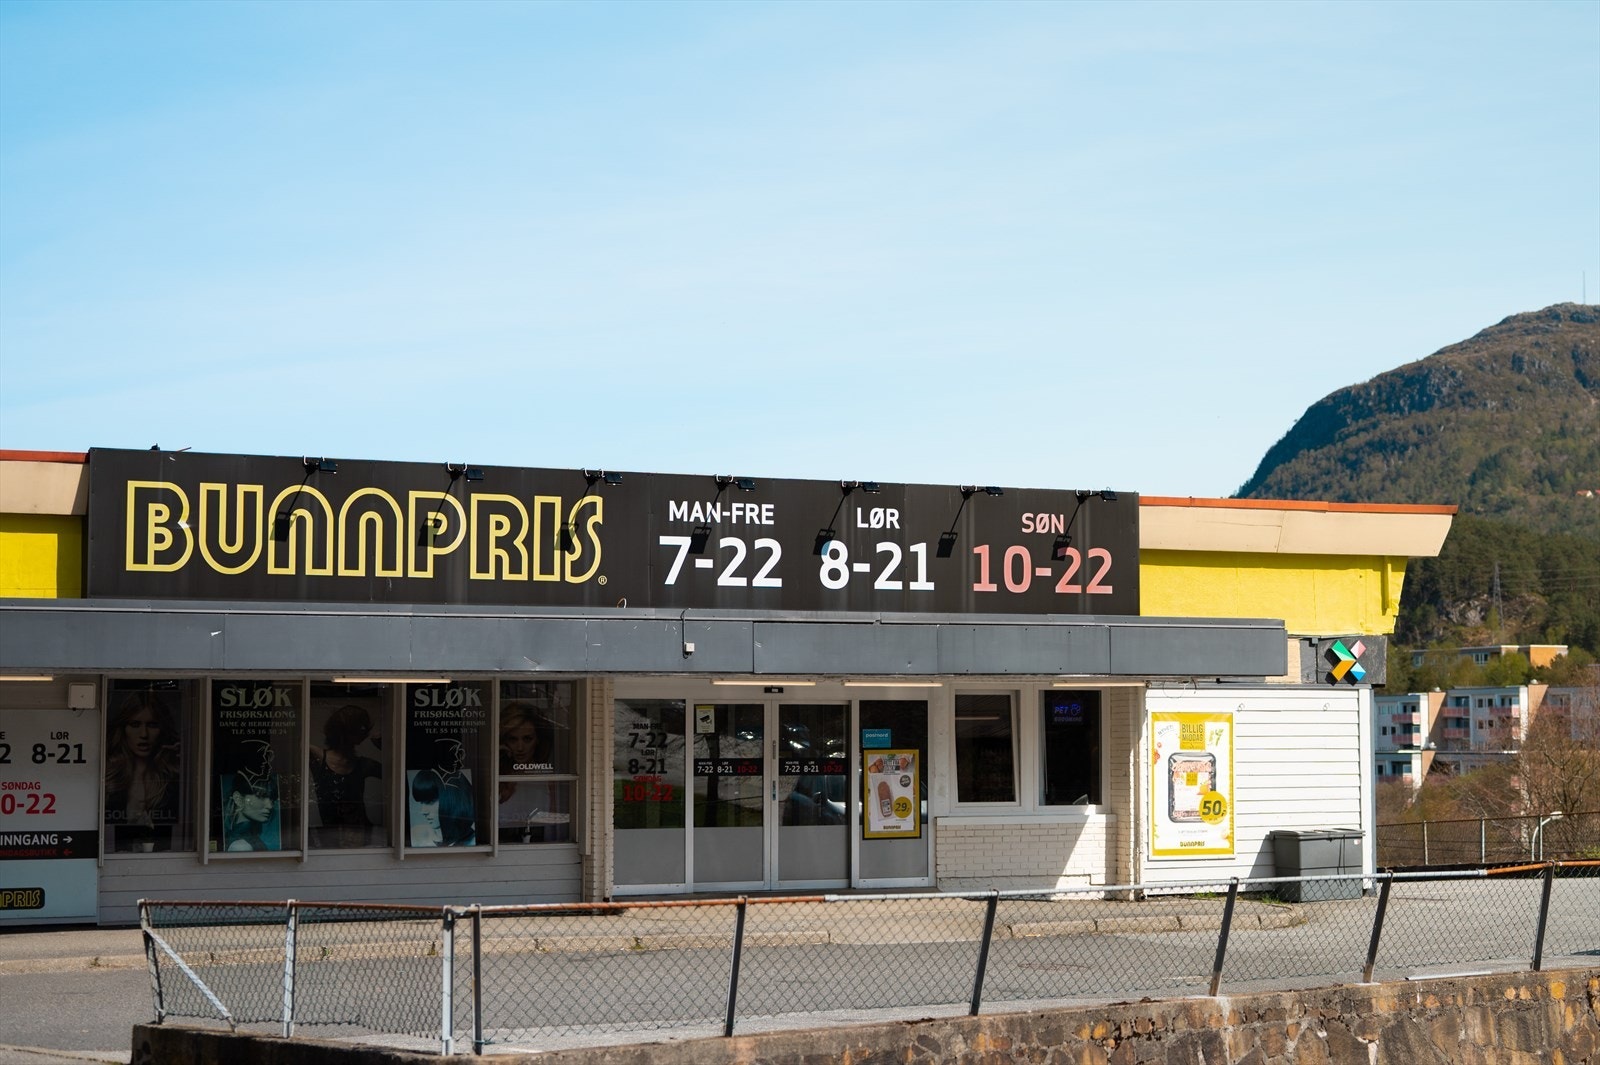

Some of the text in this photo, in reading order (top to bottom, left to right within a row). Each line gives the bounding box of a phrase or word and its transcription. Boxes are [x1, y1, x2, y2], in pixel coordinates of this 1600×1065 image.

[668, 500, 775, 525] MAN-FRE
[857, 507, 901, 530] LØR
[1021, 512, 1065, 534] SØN
[126, 480, 603, 584] BUNNPRIS
[659, 535, 783, 588] 7-22
[819, 540, 935, 590] 8-21
[972, 544, 1114, 595] 10-22
[220, 686, 293, 709] SLØK
[414, 687, 482, 709] SLØK
[220, 710, 297, 719] FRISØRSALONG
[414, 710, 486, 719] FRISØRSALONG
[1054, 704, 1069, 714] PET
[50, 731, 70, 740] LØR
[1181, 723, 1204, 734] BILLIG
[628, 732, 668, 749] 7-22
[32, 743, 87, 764] 8-21
[513, 763, 554, 771] GOLDWELL
[628, 758, 668, 775] 8-21
[697, 765, 714, 774] 7-22
[717, 765, 733, 774] 8-21
[784, 765, 800, 773] 7-22
[803, 765, 820, 773] 8-21
[1, 781, 41, 791] SØNDAG
[623, 784, 673, 801] 10-22
[105, 809, 177, 820] GOLWELL
[0, 890, 41, 908] PRIS
